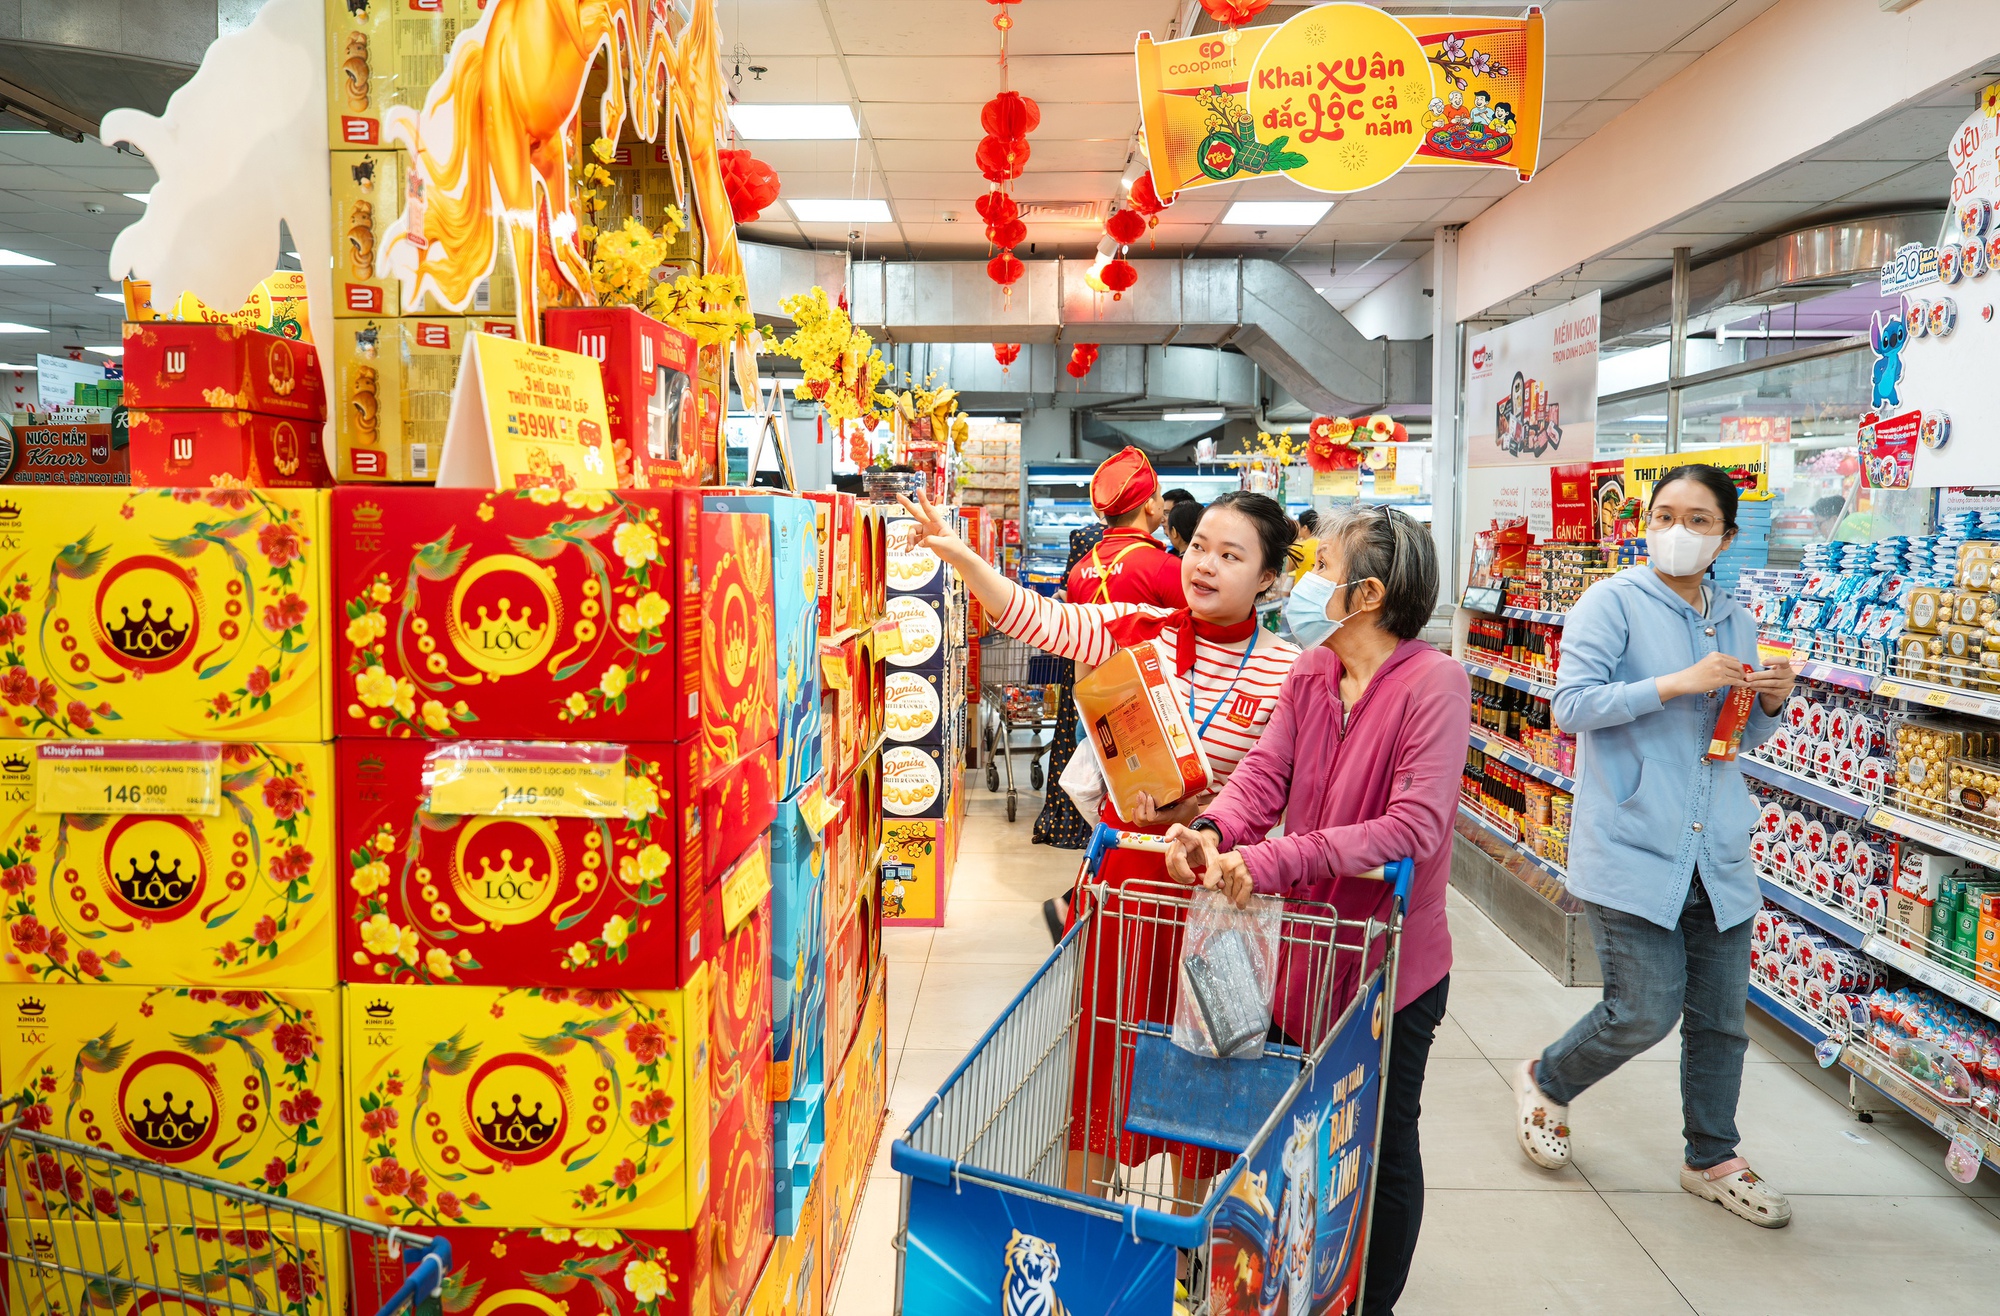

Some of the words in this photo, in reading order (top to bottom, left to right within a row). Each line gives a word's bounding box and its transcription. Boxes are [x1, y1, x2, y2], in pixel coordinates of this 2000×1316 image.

[1259, 65, 1312, 89] Khai
[1372, 86, 1397, 110] cả
[1262, 97, 1308, 129] đắc
[347, 120, 370, 140] LU
[1365, 114, 1413, 136] năm
[1953, 126, 1980, 169] YÊU
[1896, 251, 1920, 284] 20
[351, 288, 373, 308] LU
[425, 327, 445, 344] LU
[1573, 314, 1598, 341] NGON
[166, 351, 186, 374] LU
[641, 335, 654, 373] LU
[537, 364, 557, 376] NGAY
[525, 376, 532, 391] 3
[547, 382, 562, 396] GIA
[533, 394, 553, 409] TINH
[556, 398, 572, 411] CAO
[574, 398, 589, 414] CẤP
[518, 412, 558, 439] 599K
[26, 430, 59, 445] NƯỚC
[62, 427, 87, 446] MẮM
[26, 448, 87, 466] Knorr
[92, 446, 107, 456] MỚI
[174, 438, 193, 460] LU
[356, 453, 377, 472] LU
[13, 471, 33, 482] GIÀU
[34, 473, 51, 485] ĐẠM
[88, 473, 111, 486] NGỌT
[1556, 519, 1571, 540] GẮN
[1572, 518, 1587, 540] KẾT
[0, 534, 21, 551] ỘC
[124, 622, 176, 656] LỘC
[481, 622, 532, 655] LỘC
[1144, 658, 1159, 671] LU
[885, 684, 925, 702] Danisa
[1235, 698, 1254, 717] LU
[43, 745, 83, 758] Khuyến
[85, 745, 105, 757] mãi
[884, 757, 926, 777] Danisa
[5, 788, 31, 803] LỘC
[103, 785, 141, 803] 146
[143, 785, 167, 795] .000
[500, 787, 538, 805] 146
[131, 873, 183, 907] LỘC
[485, 873, 535, 905] LỘC
[21, 1029, 46, 1045] LỘC
[368, 1032, 393, 1047] LỘC
[146, 1114, 195, 1148] LỘC
[493, 1115, 543, 1150] LỘC
